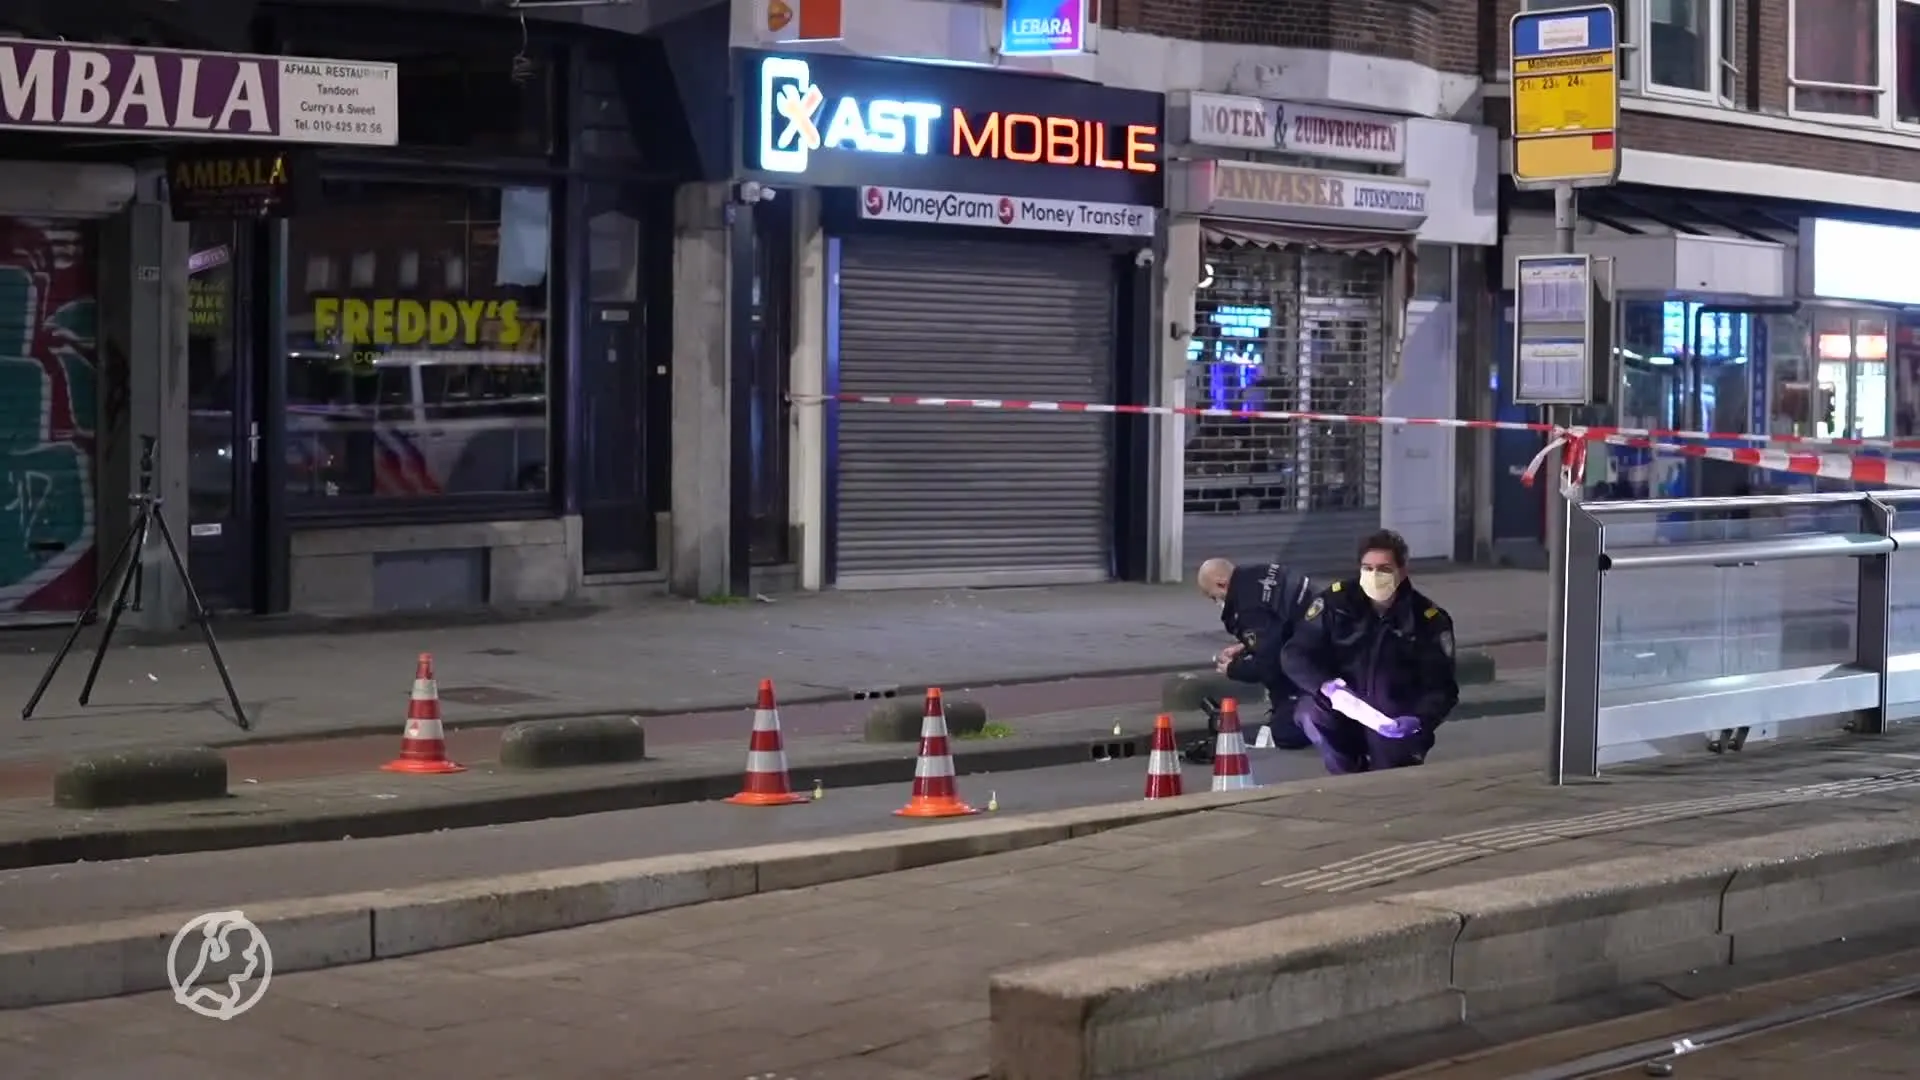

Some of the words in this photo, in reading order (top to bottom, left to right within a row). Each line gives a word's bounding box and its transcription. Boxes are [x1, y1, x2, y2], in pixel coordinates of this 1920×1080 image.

[1012, 17, 1072, 34] LEBARA
[284, 63, 322, 77] AFHAAL
[1543, 77, 1554, 90] 23
[1567, 74, 1580, 88] 24
[300, 100, 334, 114] Curry's
[337, 103, 344, 114] &
[347, 103, 376, 116] Sweet
[952, 106, 1158, 173] MOBILE
[1202, 104, 1267, 138] NOTEN
[1274, 104, 1289, 150] &
[1294, 115, 1398, 153] ZUIDVRUCHTEN
[174, 157, 289, 189] AMBALA
[1217, 167, 1345, 208] ANNASER
[887, 192, 994, 221] MoneyGram
[1021, 201, 1075, 225] Money
[1079, 205, 1143, 229] Transfer
[314, 298, 521, 344] FREDDY'S
